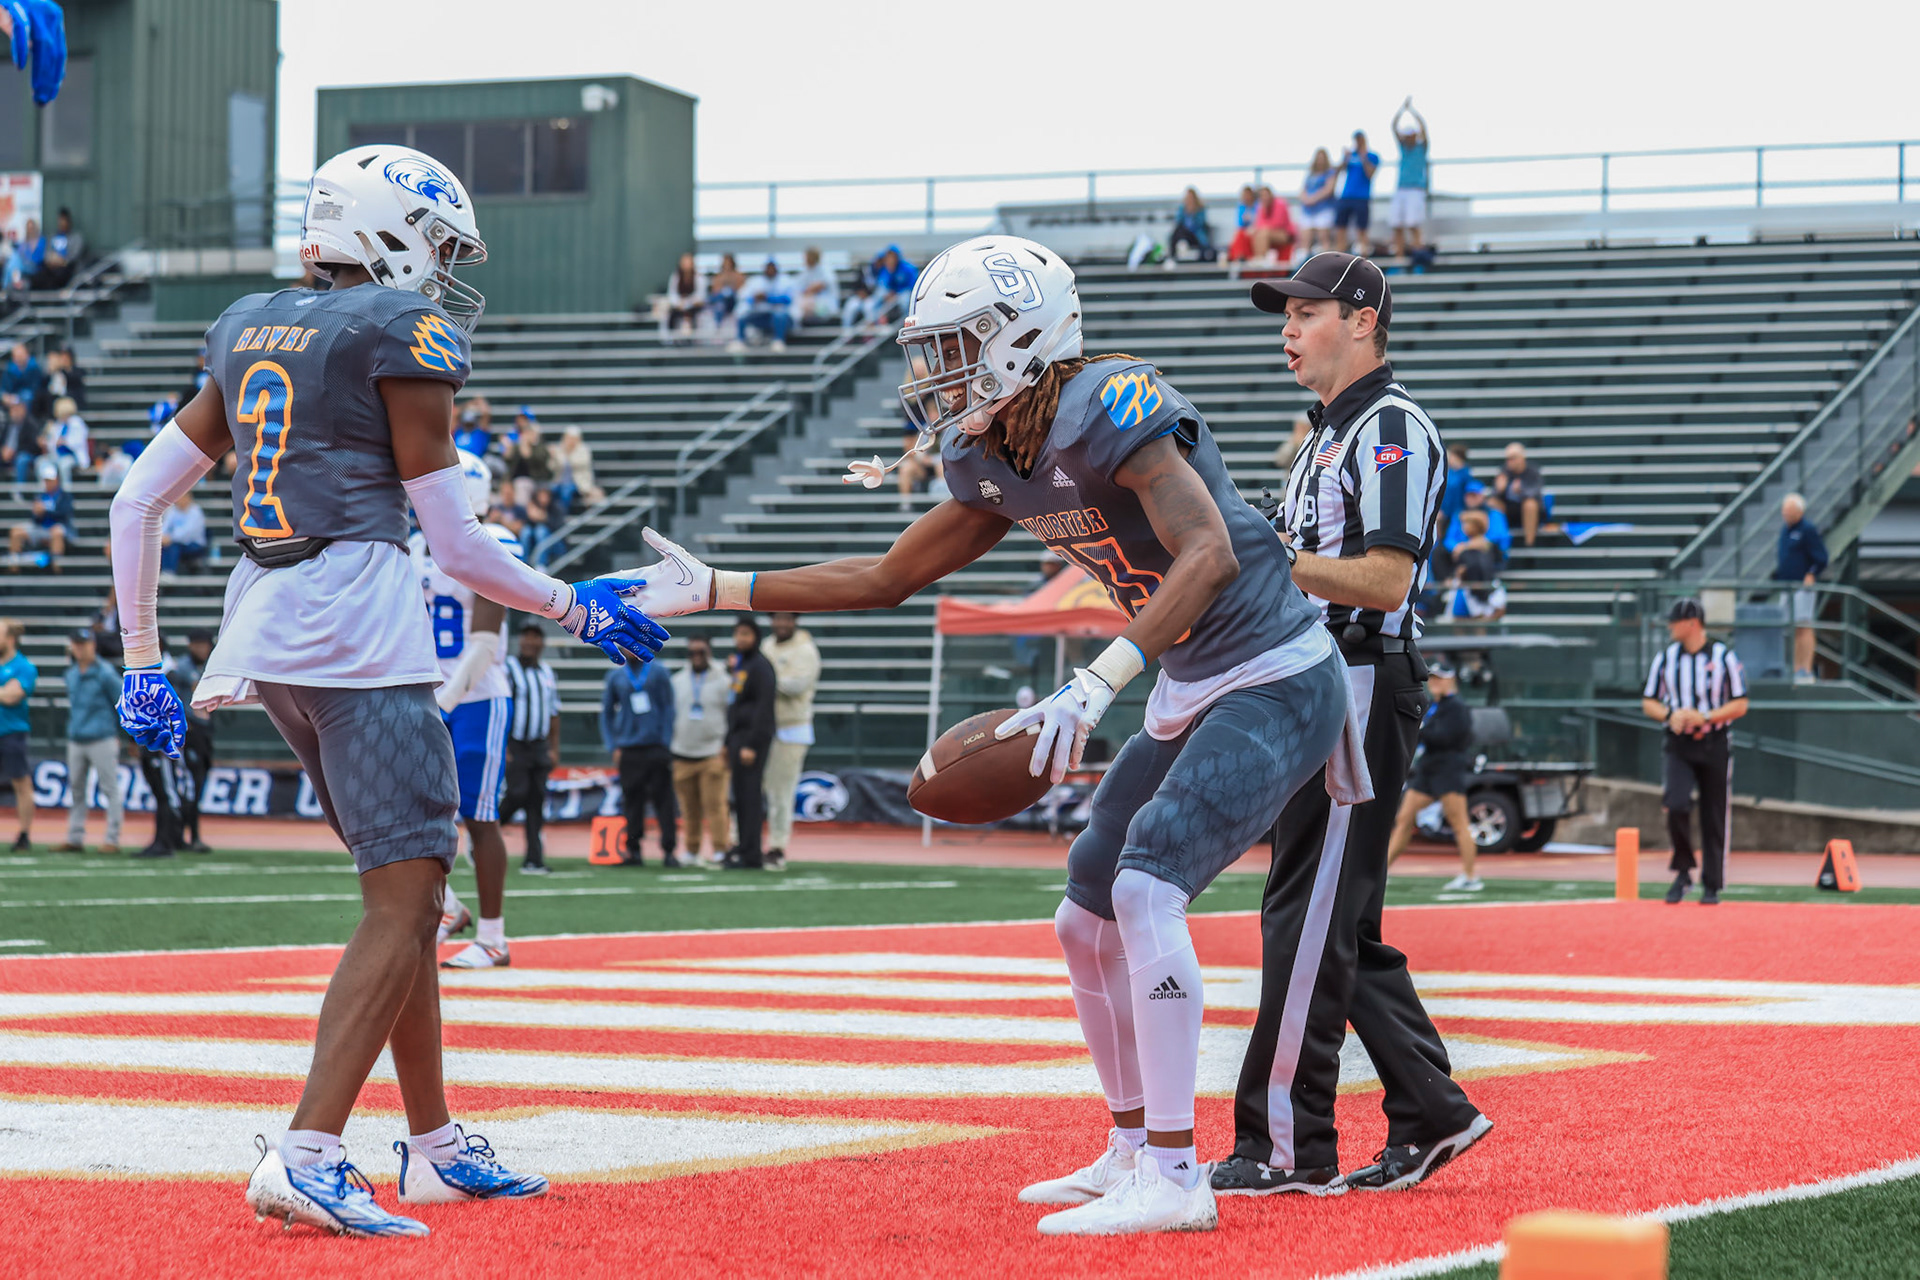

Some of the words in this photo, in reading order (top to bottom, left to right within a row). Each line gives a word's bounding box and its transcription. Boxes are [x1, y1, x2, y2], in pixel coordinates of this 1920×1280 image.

[1353, 288, 1366, 301] S
[232, 326, 320, 352] HAWKS
[236, 360, 295, 539] 2
[1380, 452, 1397, 461] CFO
[1052, 479, 1076, 488] adidas
[1018, 507, 1109, 541] HORTER
[425, 595, 464, 659] 8
[586, 599, 600, 638] adidas
[963, 732, 985, 746] NCAA
[1148, 990, 1188, 1000] adidas
